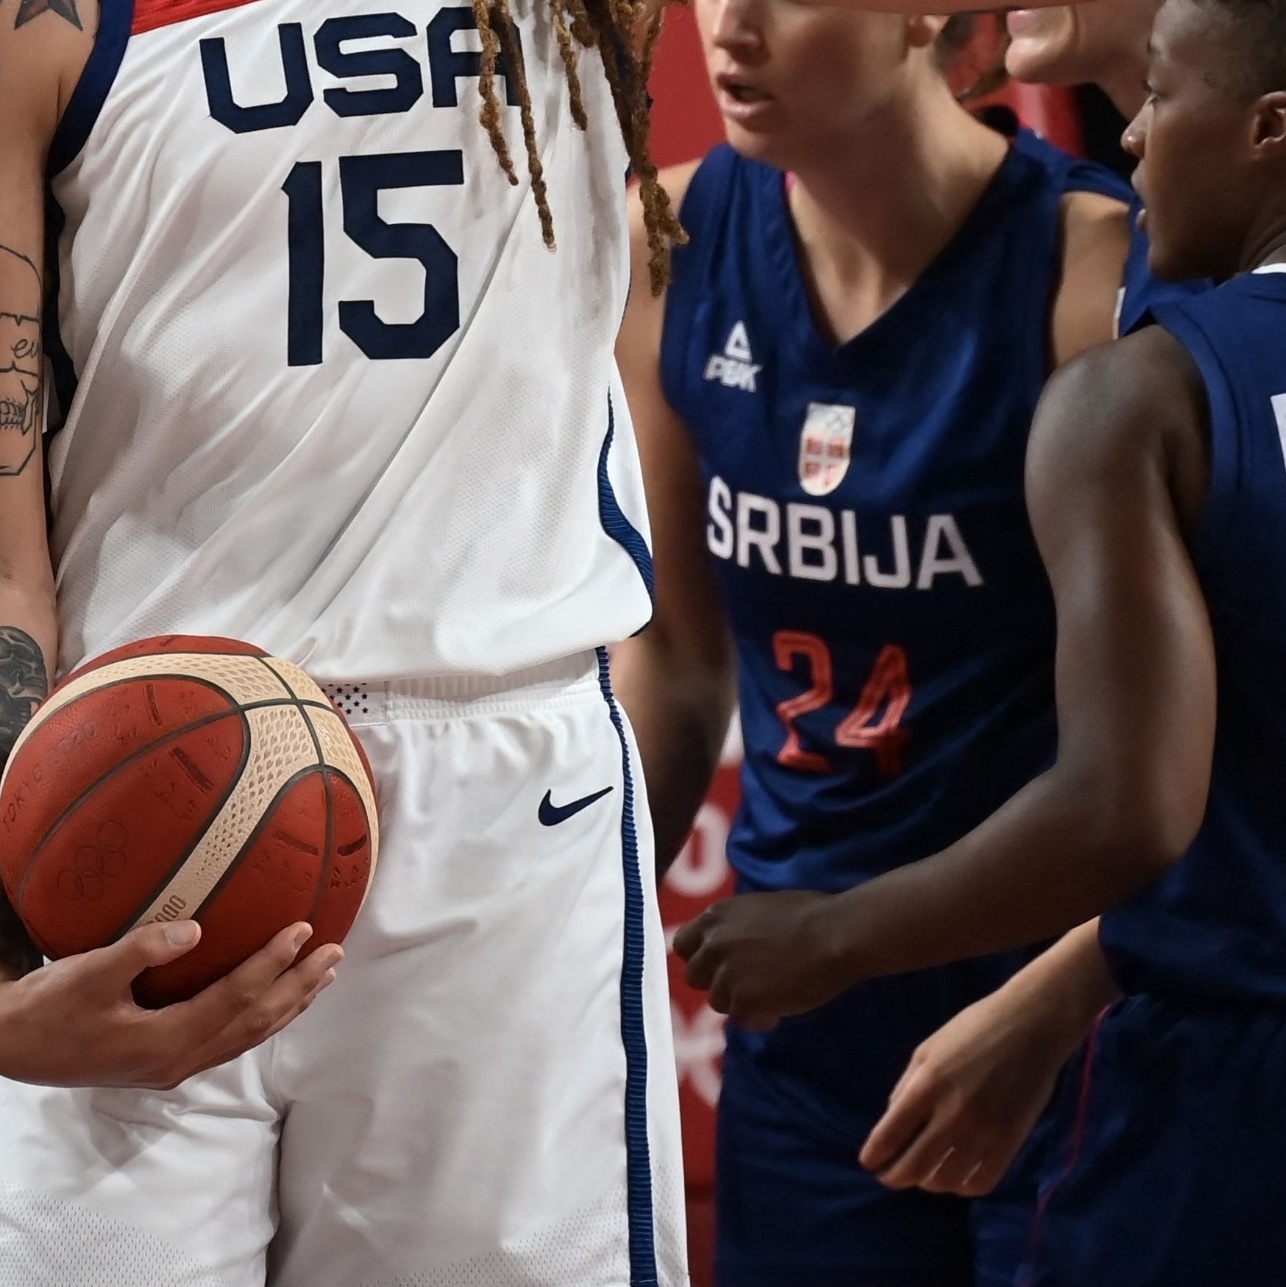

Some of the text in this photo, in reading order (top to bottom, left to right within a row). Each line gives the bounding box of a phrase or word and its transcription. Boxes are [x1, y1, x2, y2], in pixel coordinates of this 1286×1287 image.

[199, 7, 522, 134] USA
[281, 149, 464, 367] 15
[706, 475, 984, 590] SRBIJA
[772, 629, 914, 775] 24
